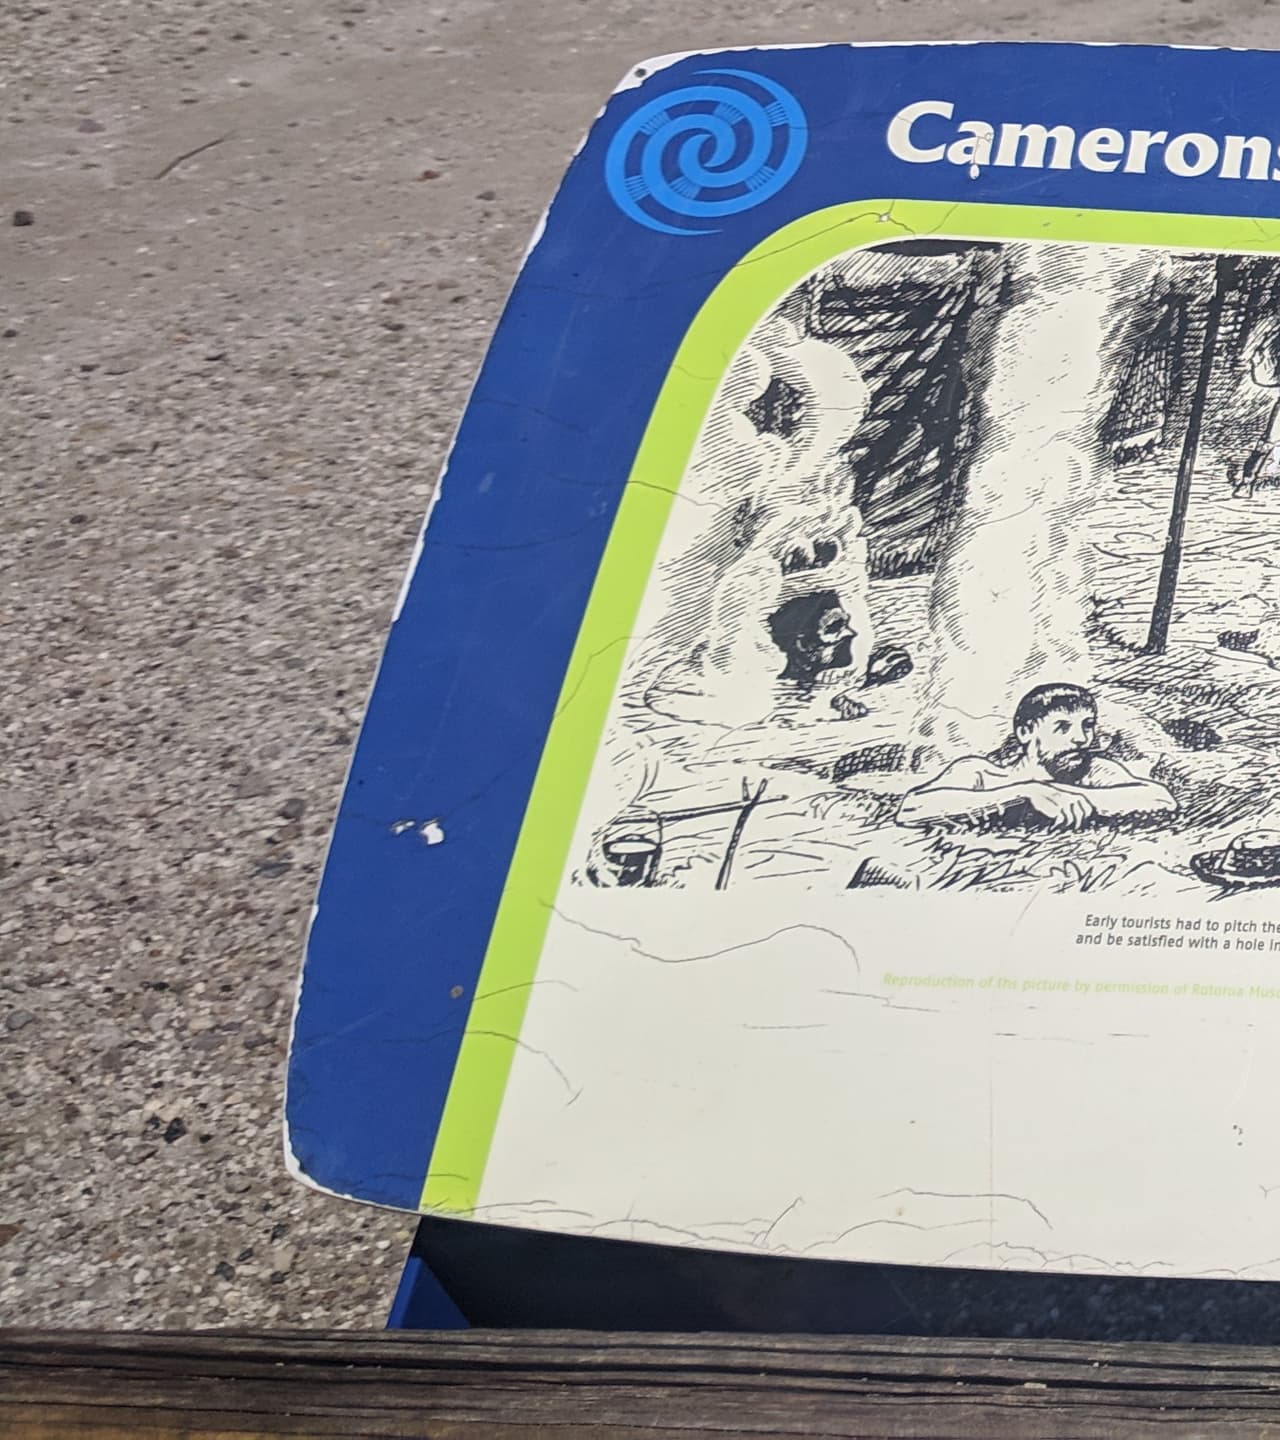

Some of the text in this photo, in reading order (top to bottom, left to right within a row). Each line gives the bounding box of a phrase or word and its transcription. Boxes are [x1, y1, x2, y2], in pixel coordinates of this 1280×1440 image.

[1084, 913, 1118, 930] Early
[1121, 916, 1171, 929] tourists
[1175, 917, 1202, 930] had
[1205, 919, 1219, 931] to
[1222, 919, 1257, 934] pitch
[1075, 932, 1103, 945] and
[1106, 932, 1123, 946] be
[1126, 934, 1184, 948] satisfied
[1187, 935, 1218, 949] with
[1222, 939, 1231, 950] a
[1235, 937, 1265, 951] hole
